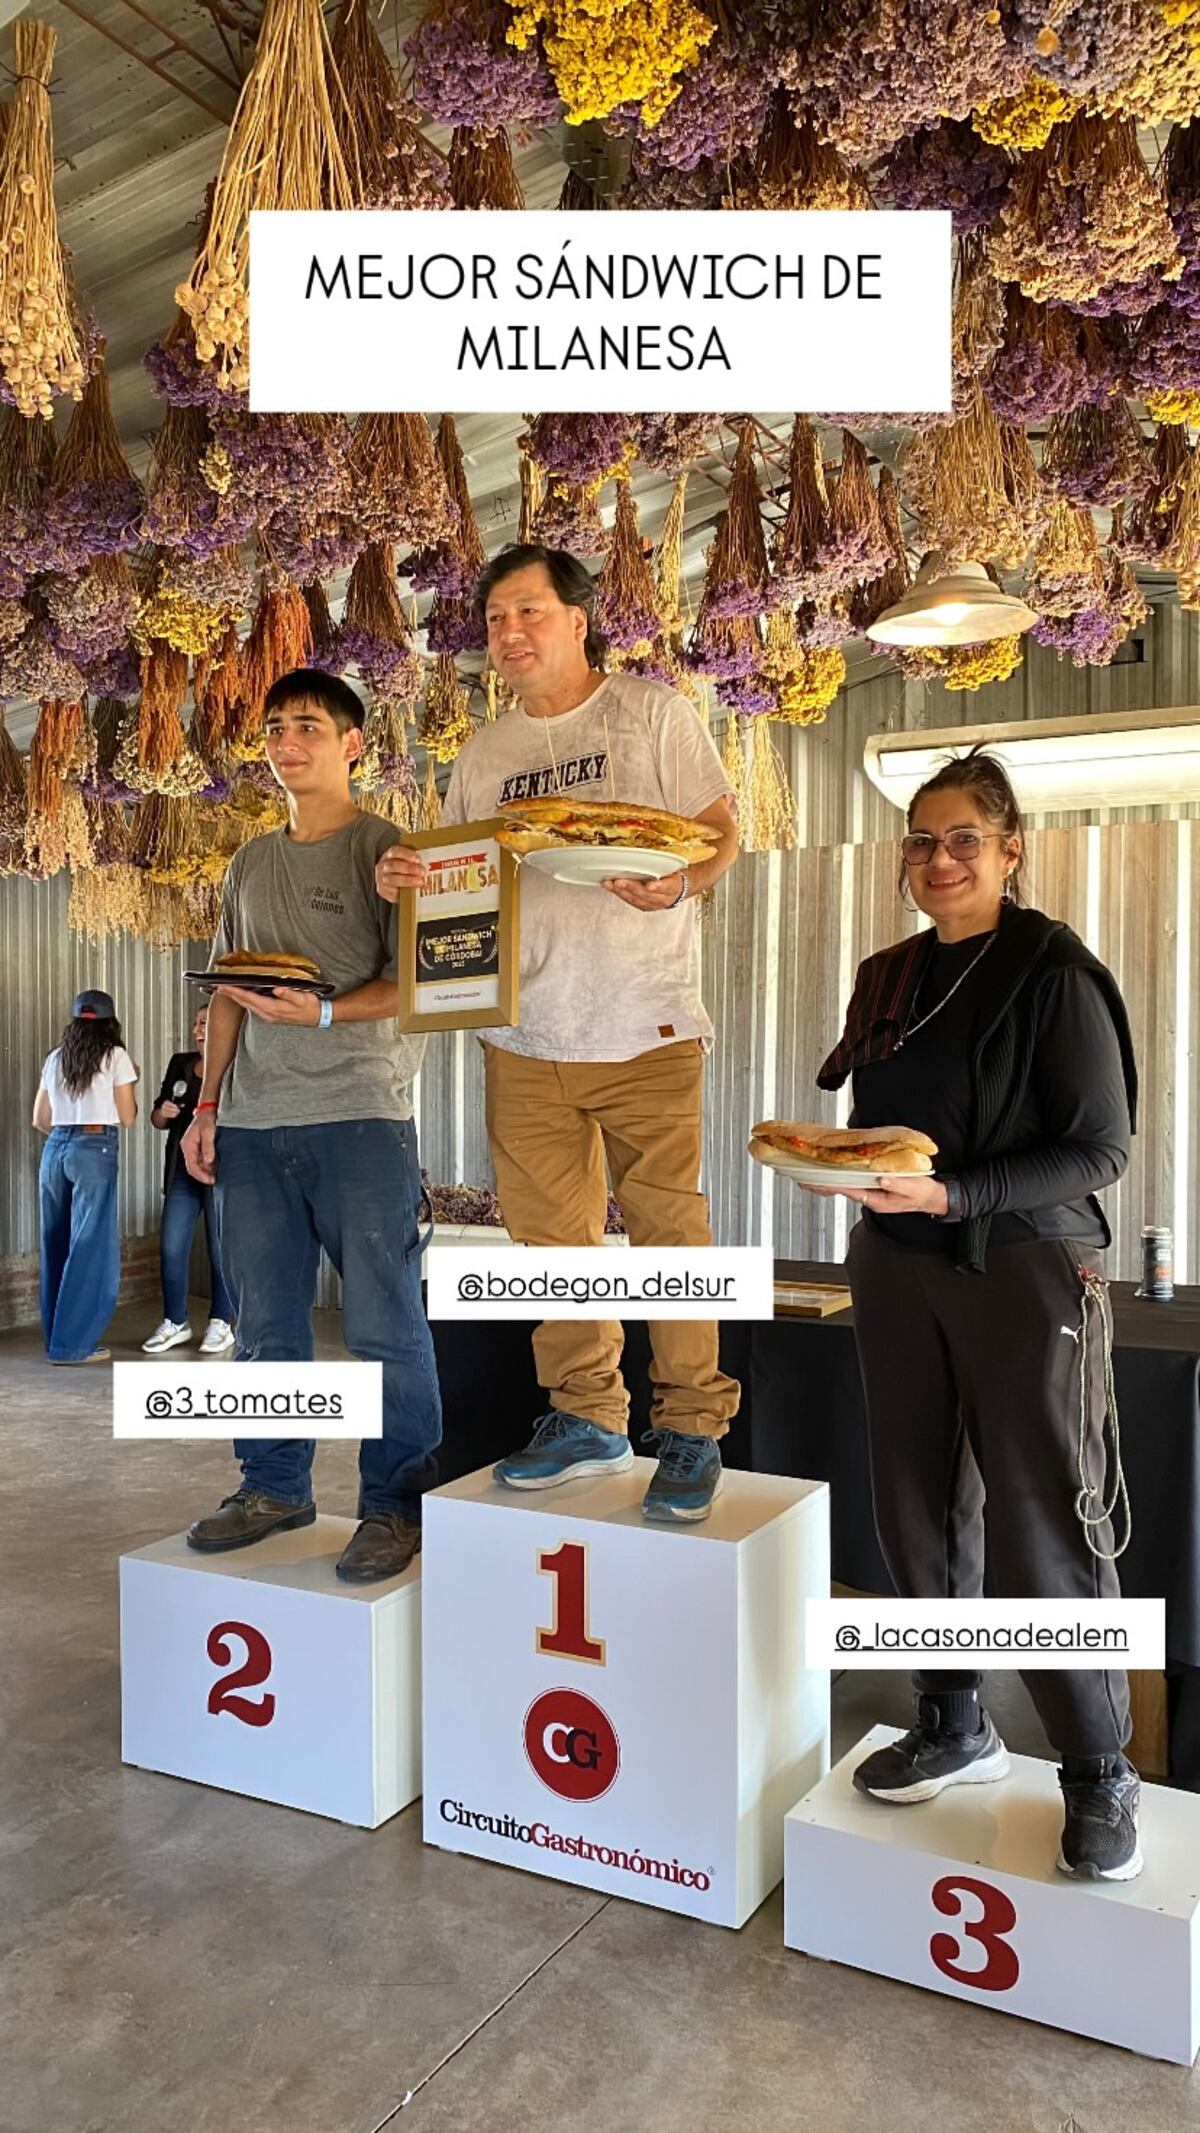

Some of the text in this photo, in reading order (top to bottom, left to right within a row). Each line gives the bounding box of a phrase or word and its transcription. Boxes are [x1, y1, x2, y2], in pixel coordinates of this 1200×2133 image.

[498, 752, 607, 803] KENTUCKY
[535, 1540, 606, 1665] 1
[208, 1622, 274, 1726] 2
[542, 1722, 602, 1770] CG
[930, 1875, 1019, 1992] 3
